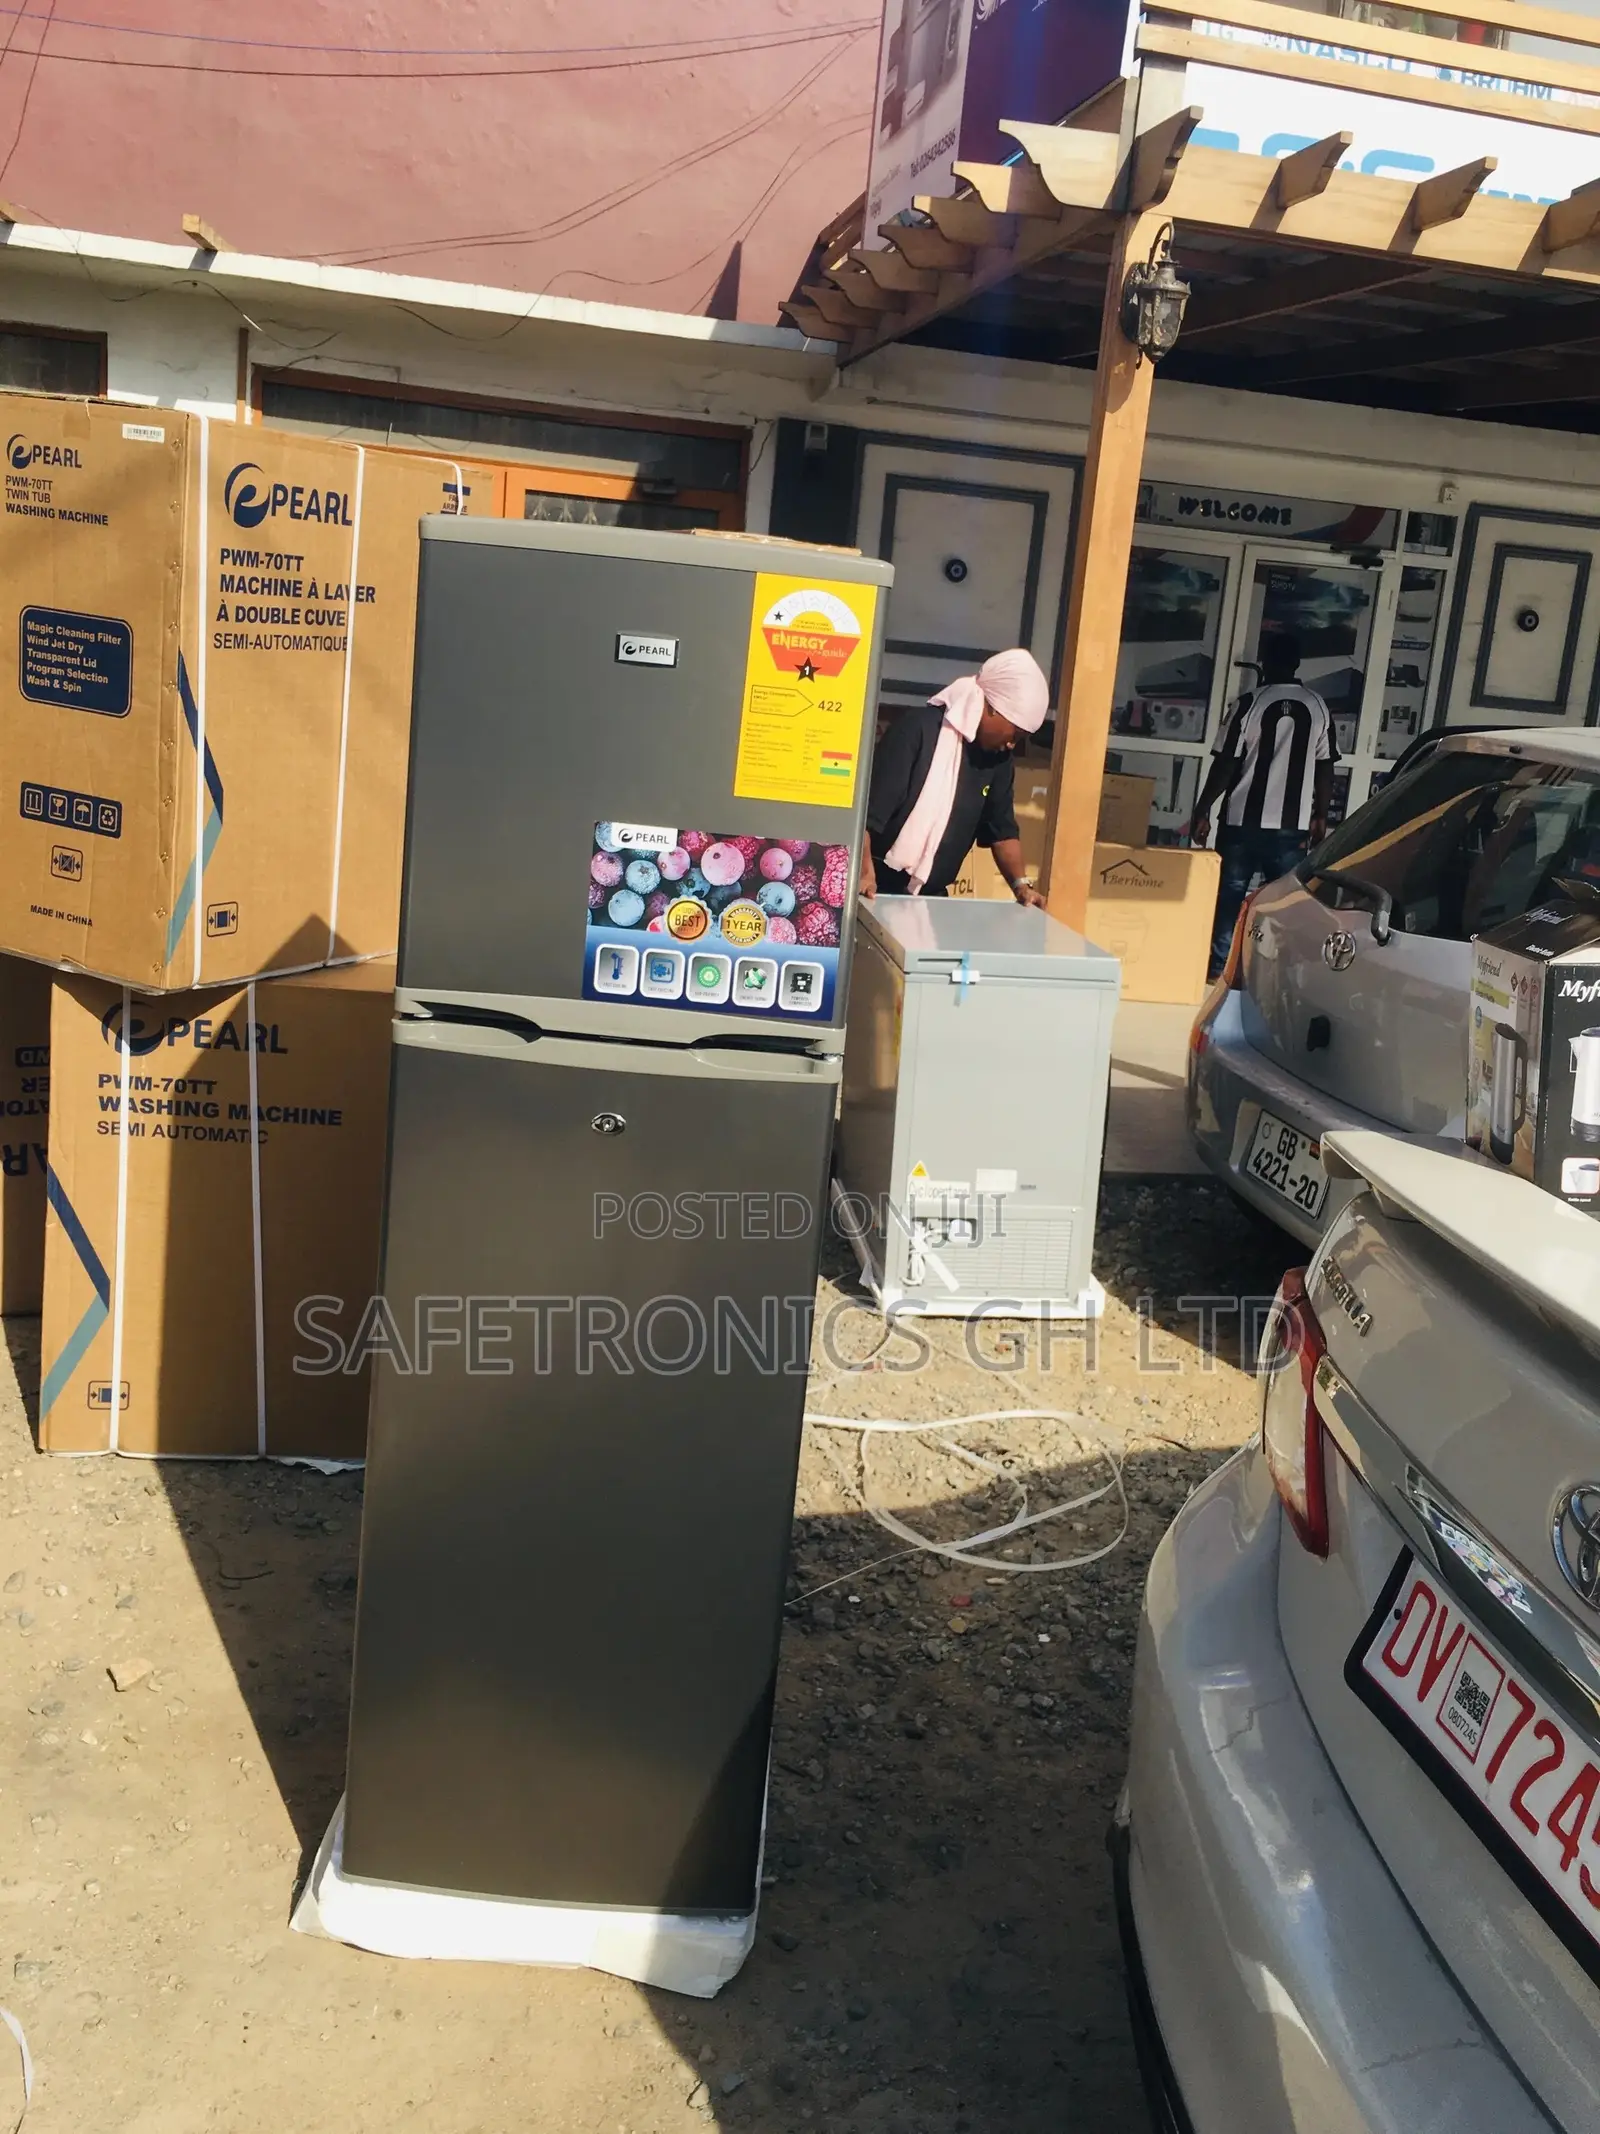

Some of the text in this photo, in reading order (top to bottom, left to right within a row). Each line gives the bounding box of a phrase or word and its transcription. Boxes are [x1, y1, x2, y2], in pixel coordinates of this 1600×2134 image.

[32, 444, 82, 469] PEARL
[5, 475, 53, 491] PWM-70TT
[5, 488, 51, 504] TWIN TUB
[270, 483, 353, 527] PEARL
[5, 502, 109, 526] WASHING MACHINE
[1178, 496, 1292, 526] WELCOME
[219, 547, 304, 572] PWM-70TT
[219, 574, 303, 598] MACHINE
[306, 577, 319, 600] À
[216, 599, 346, 627] À DOUBLE CUVE
[26, 620, 122, 645] Magic Cleaning Filter
[26, 634, 84, 654] Wind Jet Dry
[213, 632, 348, 652] SEMI-AUTOMATIQUE
[771, 630, 828, 650] ENERGY
[26, 647, 97, 668] Transparent Lid
[638, 645, 672, 657] PEARL
[26, 661, 109, 684] Program Selection
[804, 665, 810, 676] 1
[26, 674, 82, 693] Wash & Spin
[817, 700, 843, 713] 422
[635, 832, 670, 845] PEARL
[952, 878, 973, 896] TCL
[30, 904, 93, 927] MADE IN CHINA
[675, 914, 701, 927] BEST
[729, 907, 761, 920] WARRANTY
[726, 920, 762, 932] 1 YEAR
[1558, 979, 1600, 1003] Myf
[167, 1017, 288, 1055] PEARL
[98, 1073, 217, 1096] PWM-70TT
[96, 1120, 269, 1145] SEMI AUTOMATC
[1277, 1127, 1299, 1161] GB
[1252, 1147, 1319, 1210] 4221-20
[1381, 1580, 1465, 1703] DV
[1447, 1706, 1478, 1745] 0807245
